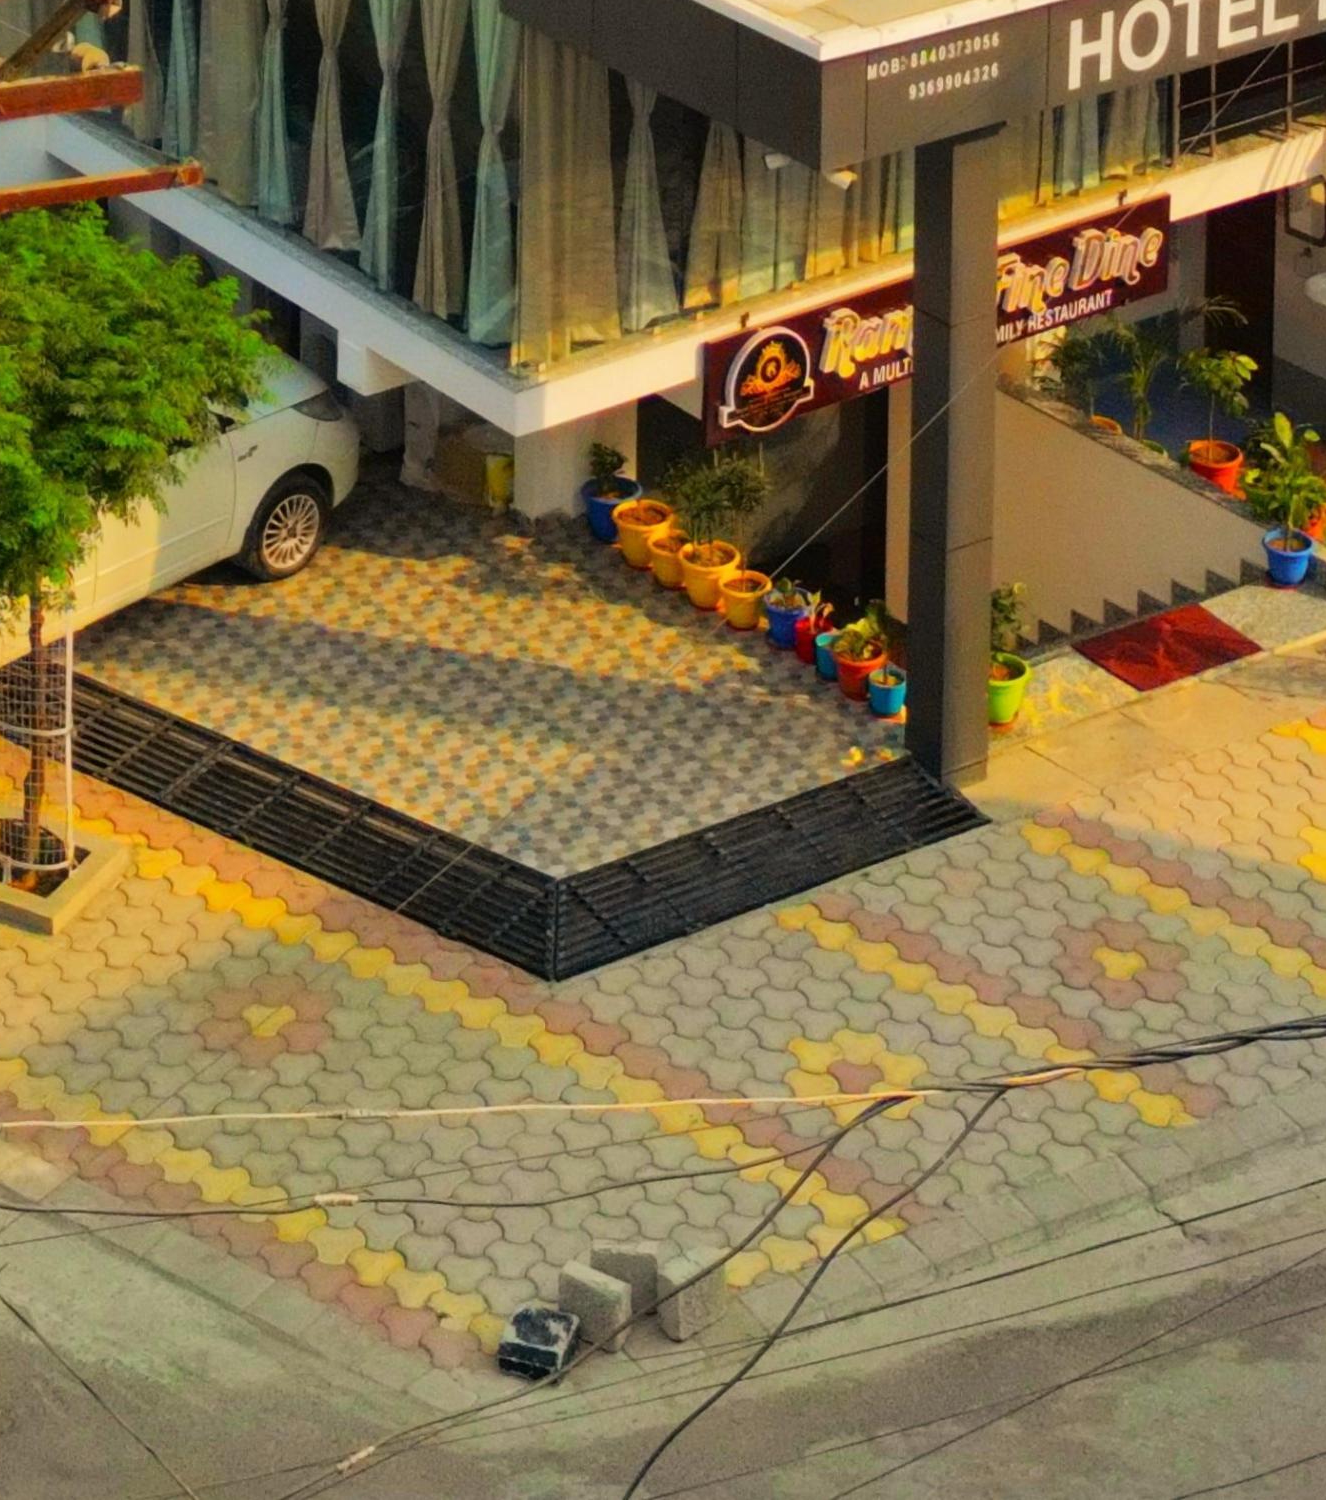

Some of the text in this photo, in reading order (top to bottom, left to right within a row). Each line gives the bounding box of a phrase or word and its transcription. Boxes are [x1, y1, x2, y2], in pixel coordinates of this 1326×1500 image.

[908, 61, 999, 101] 9369904326
[1069, 227, 1163, 291] Dine
[859, 371, 870, 391] A
[1027, 288, 1114, 333] RESTAURANT
